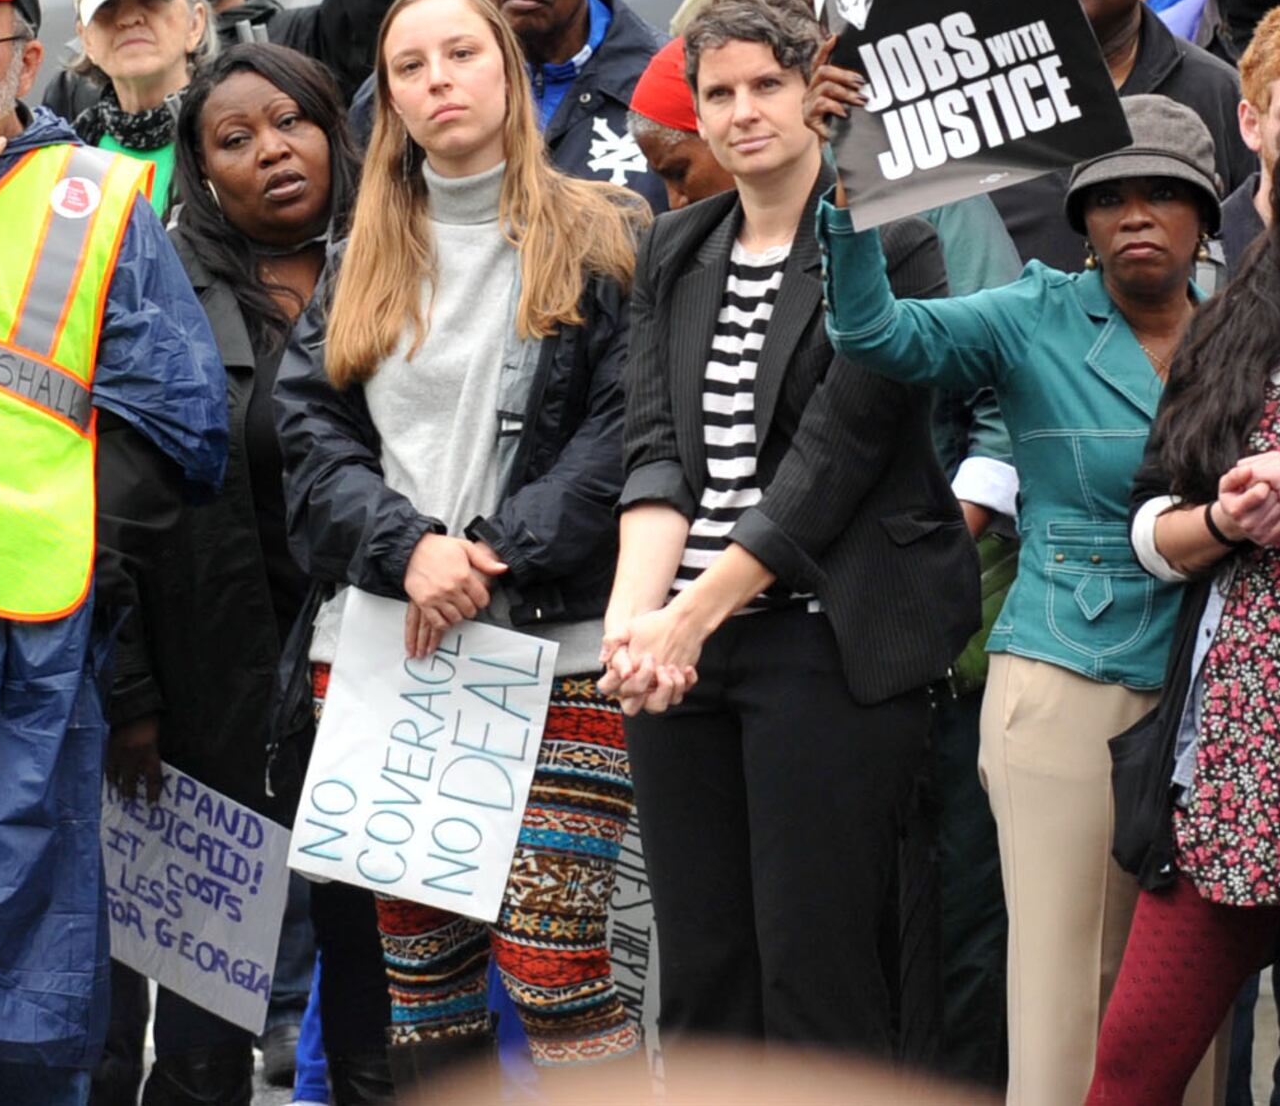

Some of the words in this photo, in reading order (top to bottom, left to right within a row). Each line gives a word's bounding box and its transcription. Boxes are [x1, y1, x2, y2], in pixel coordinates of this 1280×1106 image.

[858, 11, 990, 113] JOBS
[985, 20, 1056, 68] WITH
[877, 54, 1082, 181] JUSTICE
[438, 646, 543, 811] DEAL
[158, 773, 265, 849] XPAND
[298, 779, 357, 861] NO
[107, 826, 145, 862] IT
[166, 863, 243, 923] COSTS
[120, 864, 183, 919] LESS
[421, 817, 482, 895] NO
[155, 918, 271, 1001] GEORGIA
[608, 919, 652, 981] THEY
